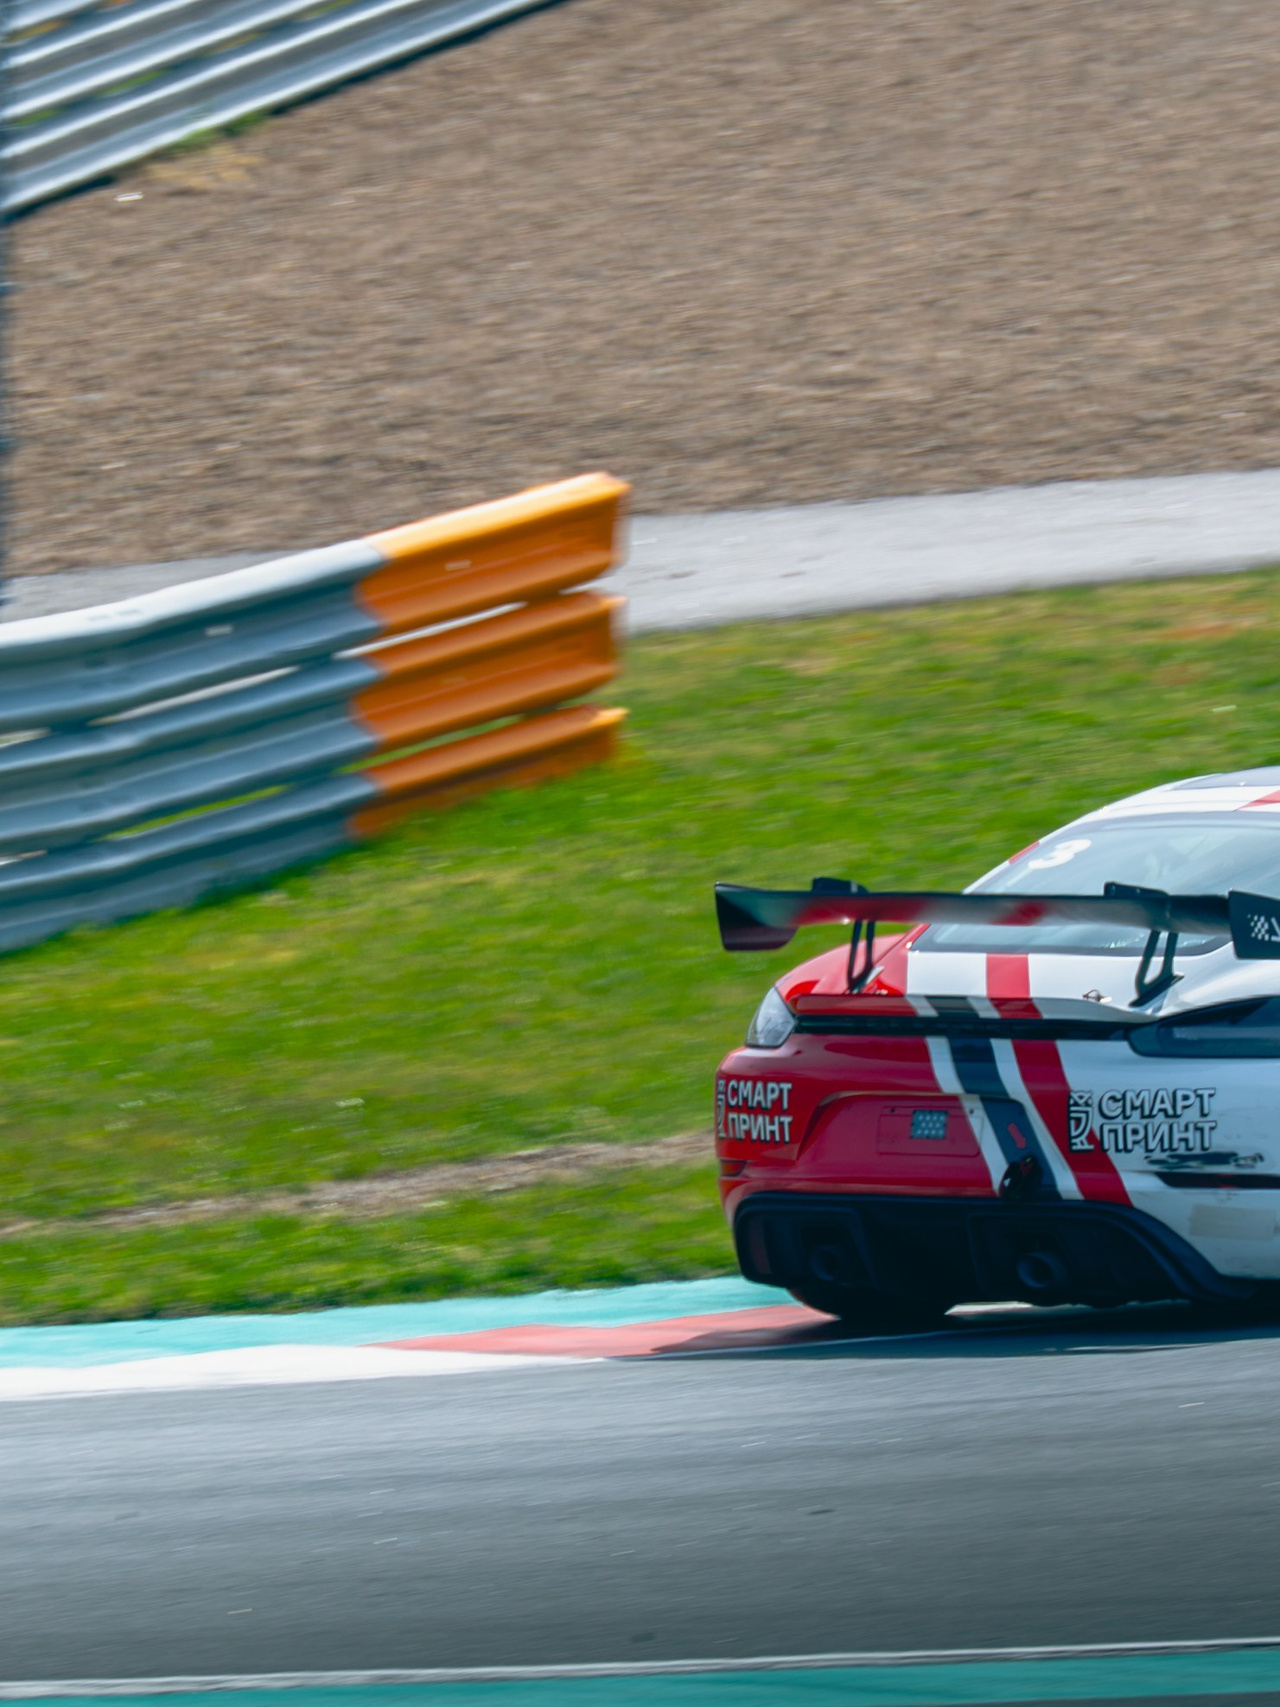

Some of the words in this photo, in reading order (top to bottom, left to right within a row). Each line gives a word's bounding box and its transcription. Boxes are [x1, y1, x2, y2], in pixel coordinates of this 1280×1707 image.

[1027, 838, 1092, 870] 3
[727, 1079, 793, 1111] СМАРТ
[1098, 1087, 1217, 1120] СМАРТ
[727, 1112, 794, 1143] ПРИНТ
[1099, 1120, 1218, 1153] ПРИНТ
